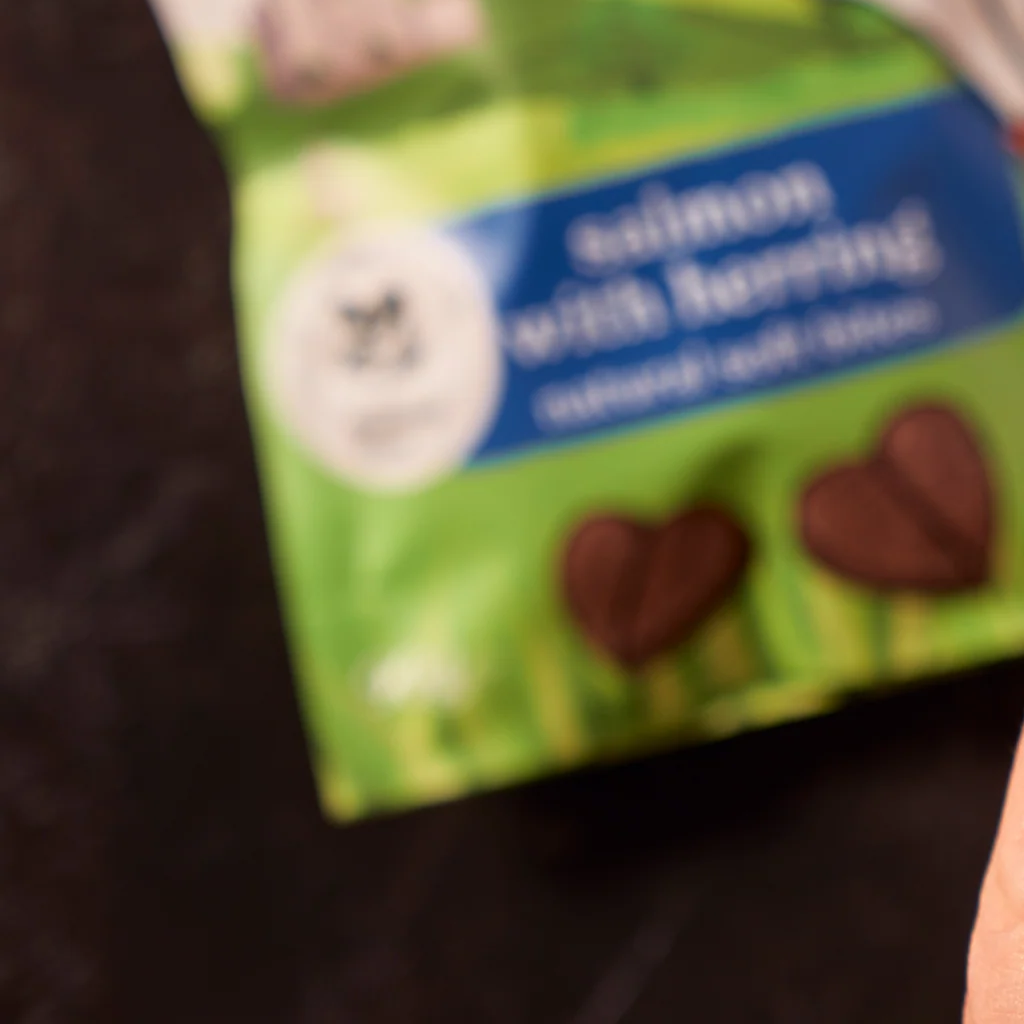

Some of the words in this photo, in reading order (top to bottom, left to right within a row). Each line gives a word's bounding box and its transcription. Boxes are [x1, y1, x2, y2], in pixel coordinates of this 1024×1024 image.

[502, 273, 668, 364] with
[668, 204, 940, 325] herring
[571, 164, 832, 274] salmon
